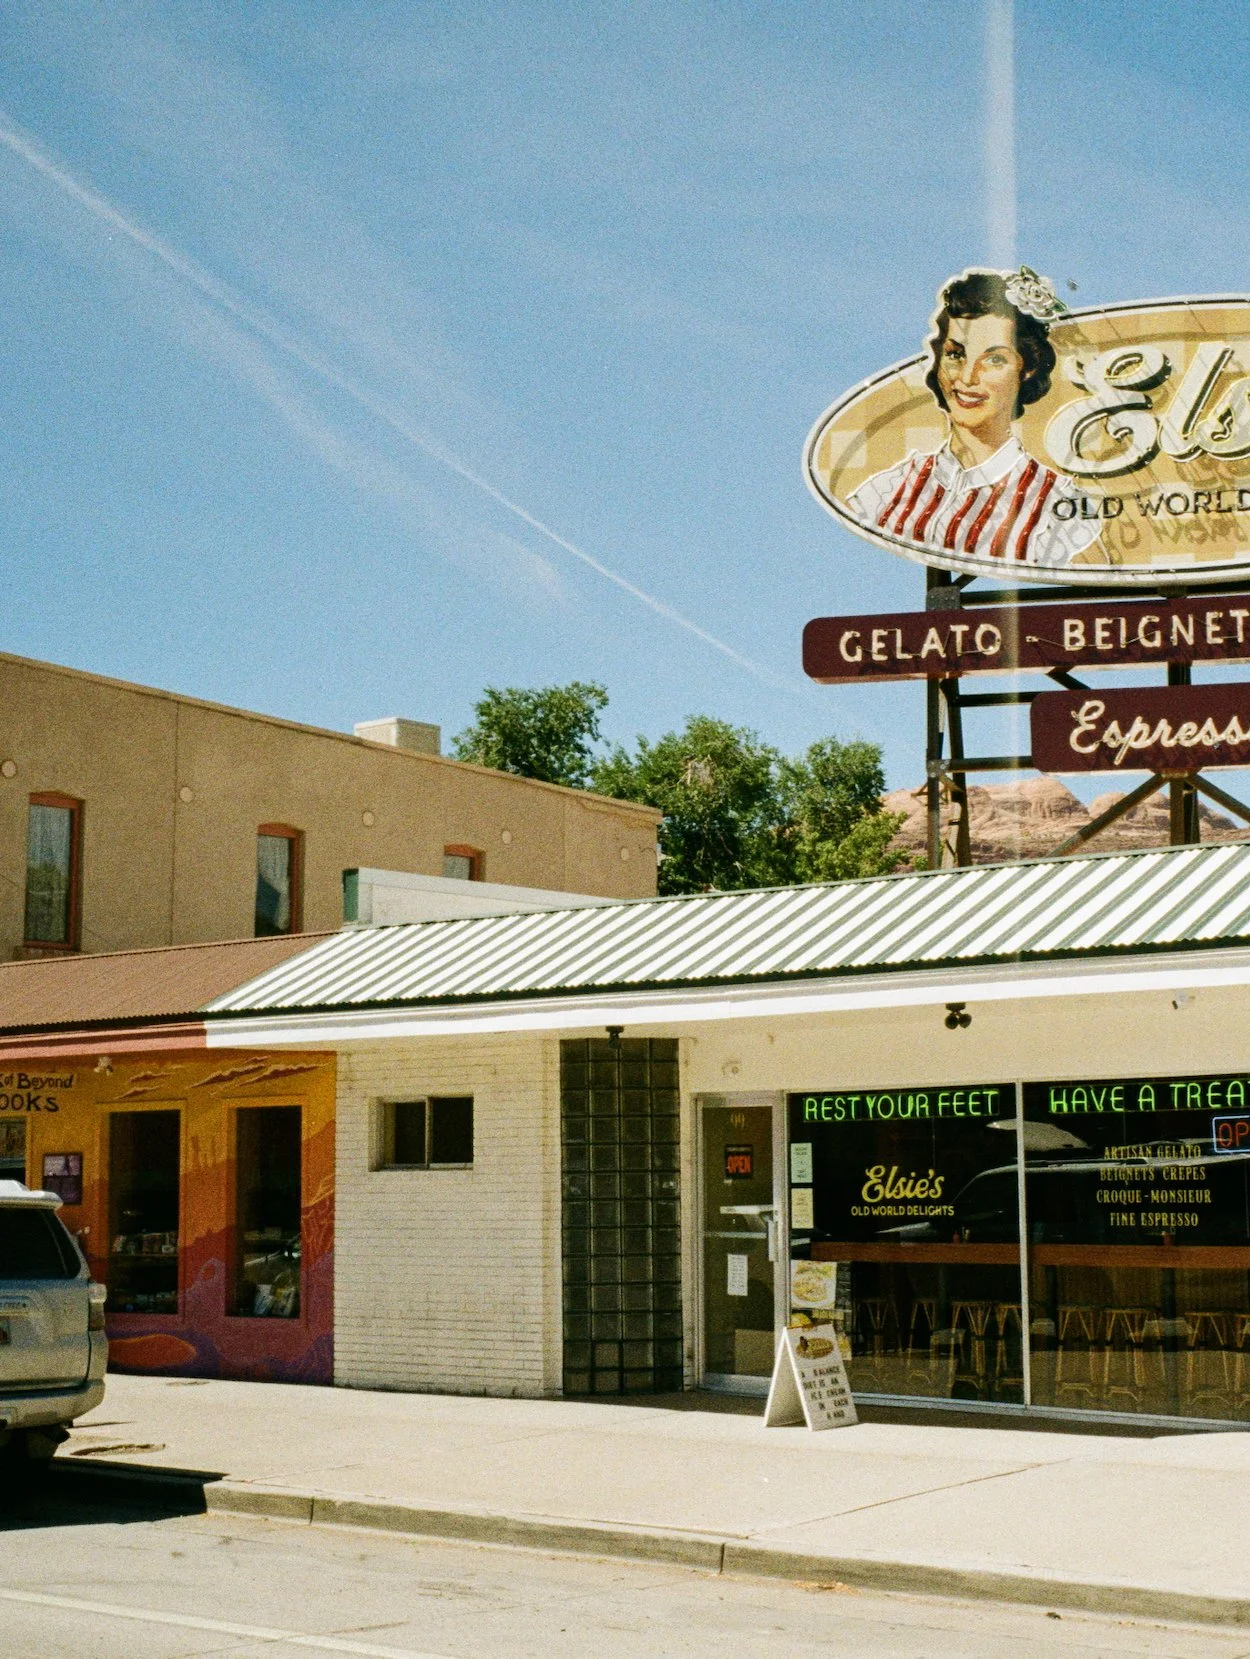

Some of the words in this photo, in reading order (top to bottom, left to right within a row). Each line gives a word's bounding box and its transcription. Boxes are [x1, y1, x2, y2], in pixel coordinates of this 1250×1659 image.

[1052, 495, 1123, 521] OLD
[838, 623, 1001, 663] GELATO
[17, 1073, 73, 1089] Beyond
[804, 1096, 861, 1121] REST
[866, 1094, 930, 1119] YOUR
[937, 1091, 999, 1117] FEET
[1049, 1086, 1125, 1113] HAVE
[1137, 1084, 1156, 1112] A
[1104, 1145, 1153, 1160] ARTISAN
[1157, 1144, 1202, 1159] GELATO
[861, 1164, 945, 1203] Elsie's
[851, 1206, 870, 1217] OLD
[871, 1205, 905, 1216] WORLD
[906, 1205, 955, 1216] DELIGHTS
[1110, 1212, 1136, 1227] FINE
[1140, 1212, 1199, 1227] ESPRESSO
